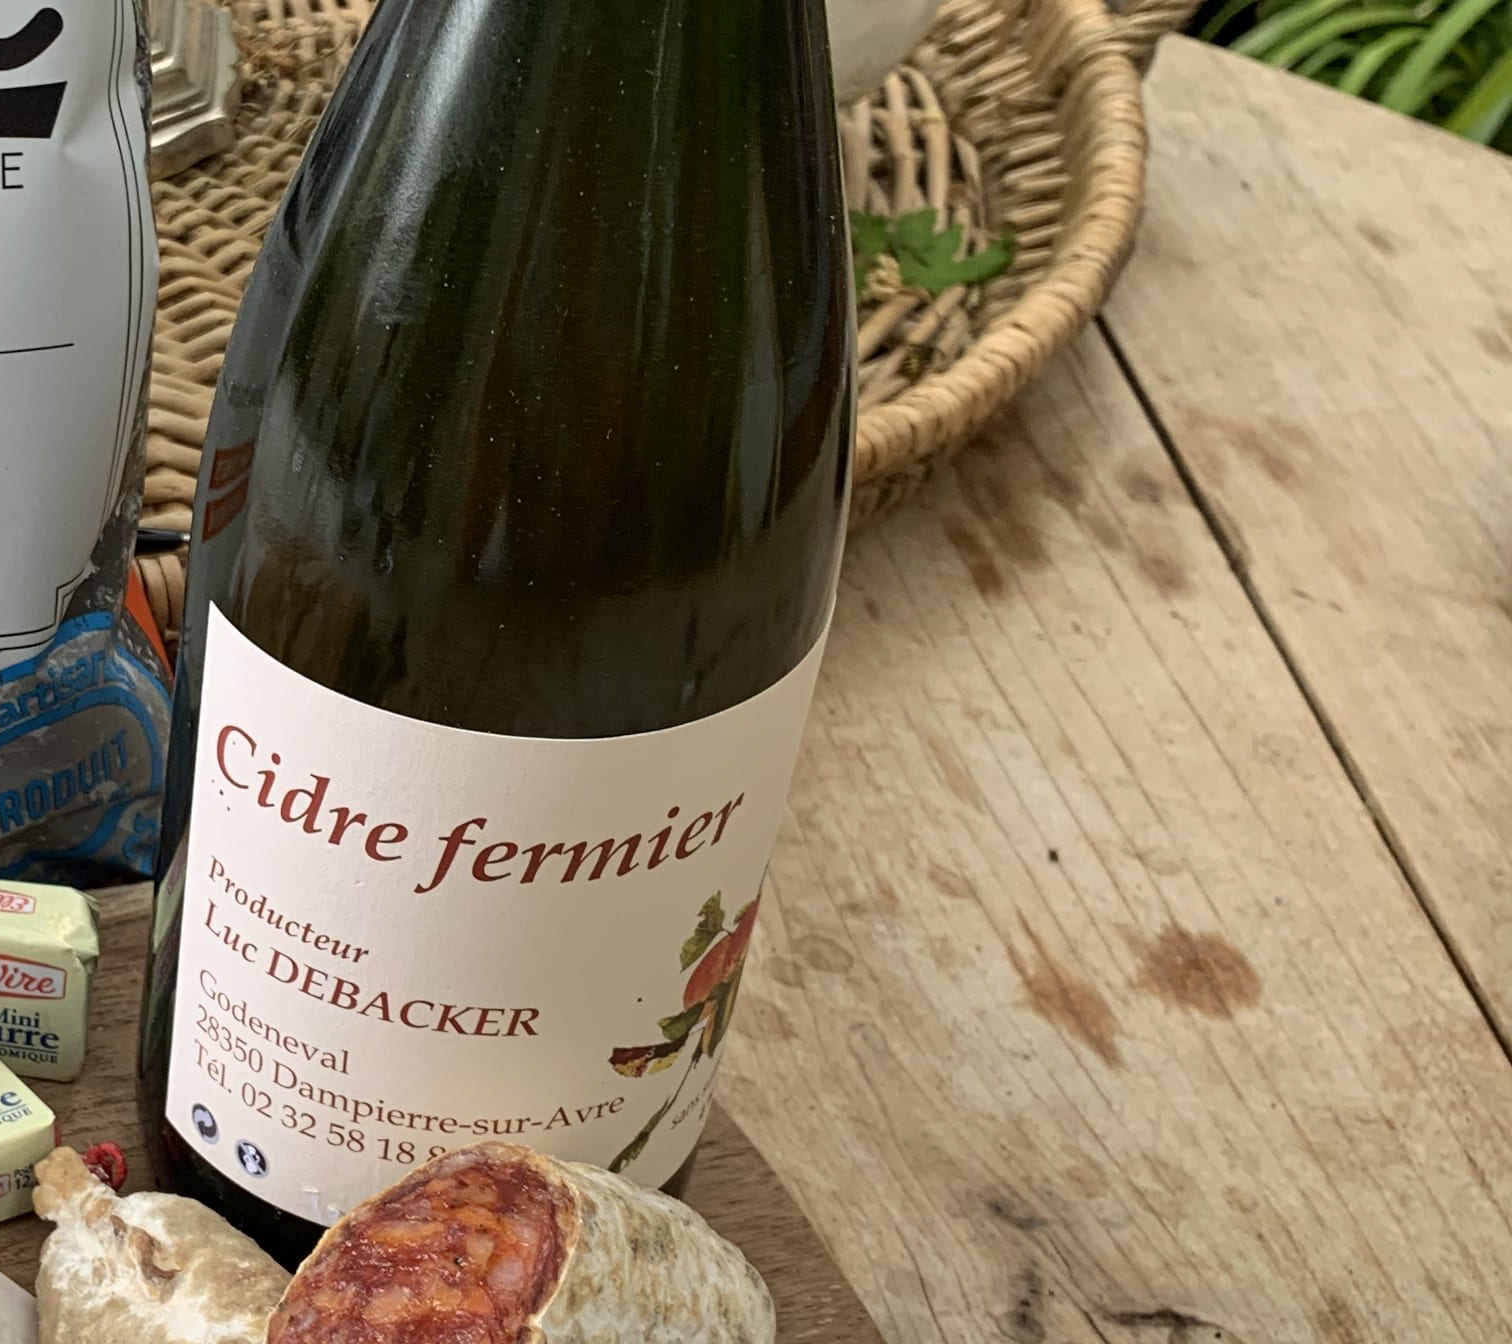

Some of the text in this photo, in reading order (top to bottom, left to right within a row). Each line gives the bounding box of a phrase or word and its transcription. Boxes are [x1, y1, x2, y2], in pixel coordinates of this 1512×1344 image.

[215, 724, 410, 863] Cidre
[413, 791, 746, 895] fermier
[202, 899, 257, 963] Luc
[265, 946, 542, 1038] DEBACKER
[207, 854, 371, 964] Producteur
[195, 1004, 264, 1074] 28350
[271, 1058, 625, 1137] Dampierre-sur-Avre
[199, 969, 350, 1075] Godeneval
[193, 1038, 233, 1094] Tél.
[240, 1081, 274, 1119] 02
[280, 1103, 318, 1140] 32
[326, 1122, 366, 1155] 58
[376, 1137, 416, 1165] 18
